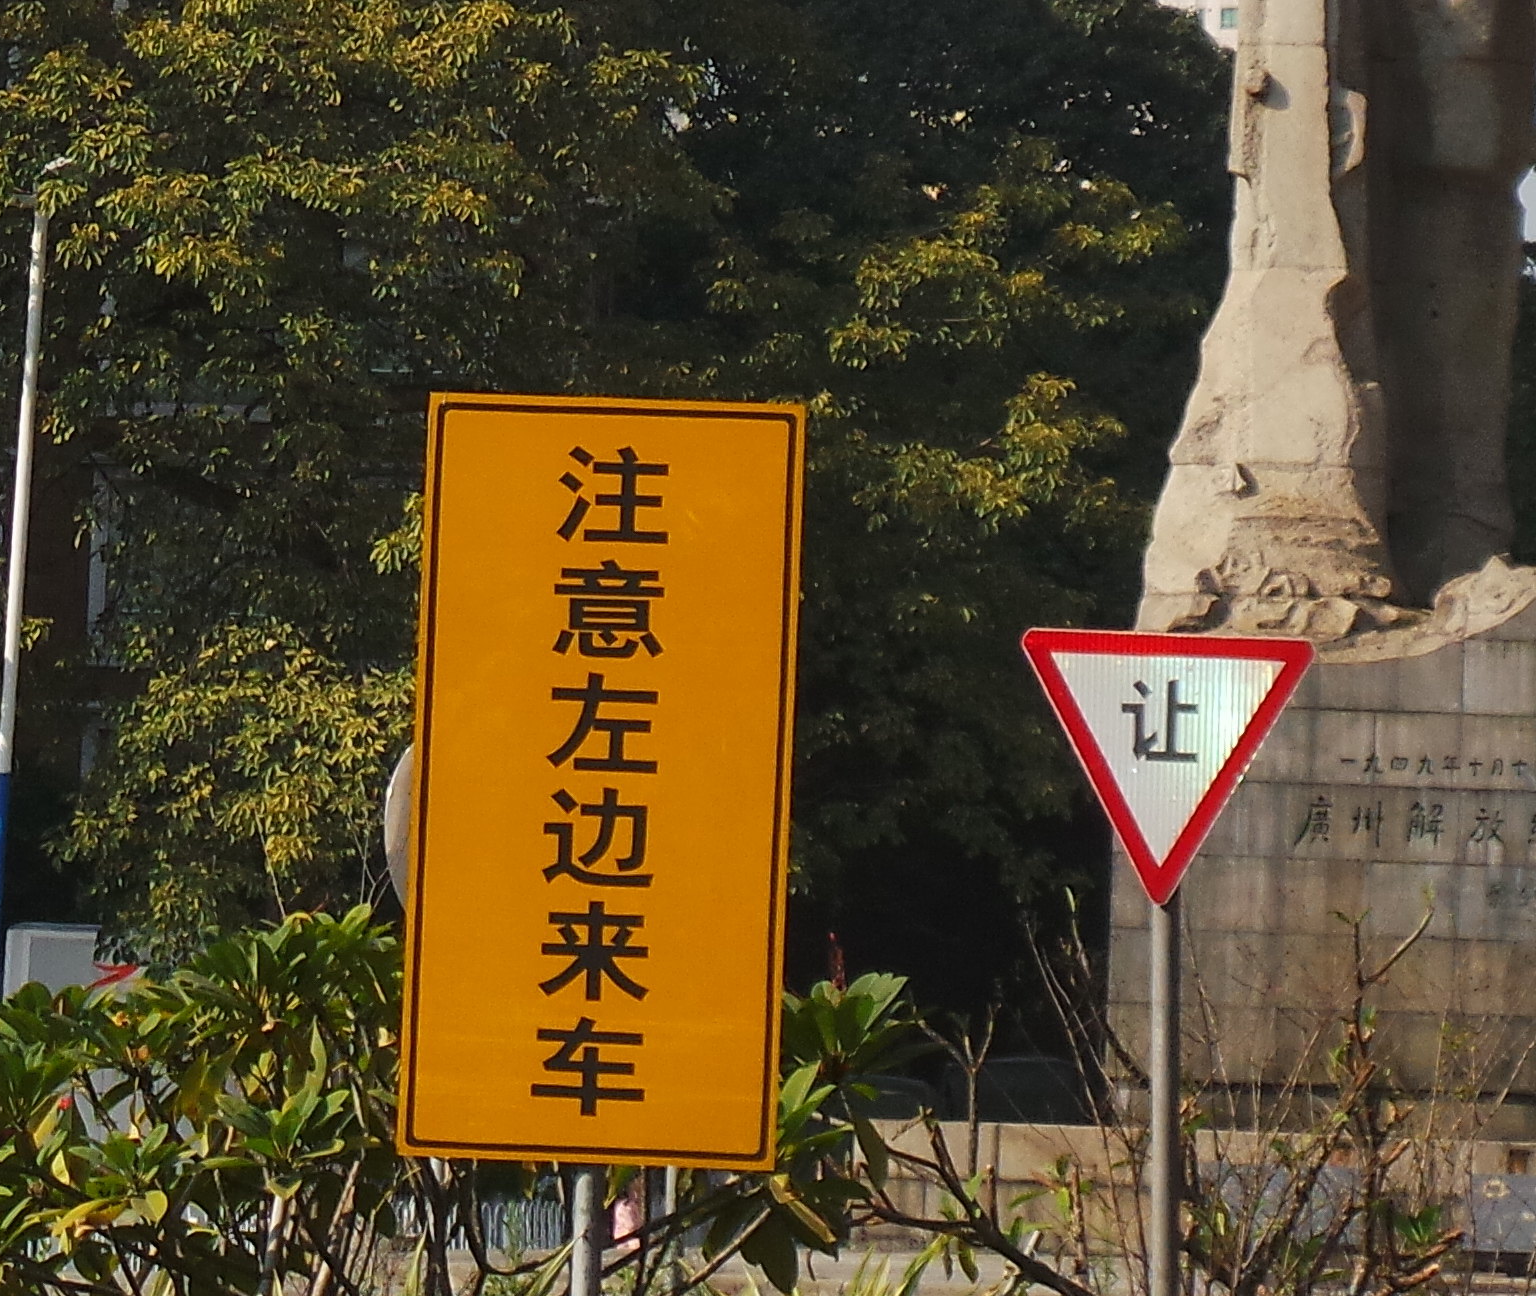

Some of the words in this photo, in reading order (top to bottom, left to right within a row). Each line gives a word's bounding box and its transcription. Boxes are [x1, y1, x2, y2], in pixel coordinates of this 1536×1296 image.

[530, 445, 670, 1116] 注意左边来车
[1121, 679, 1199, 764] 让
